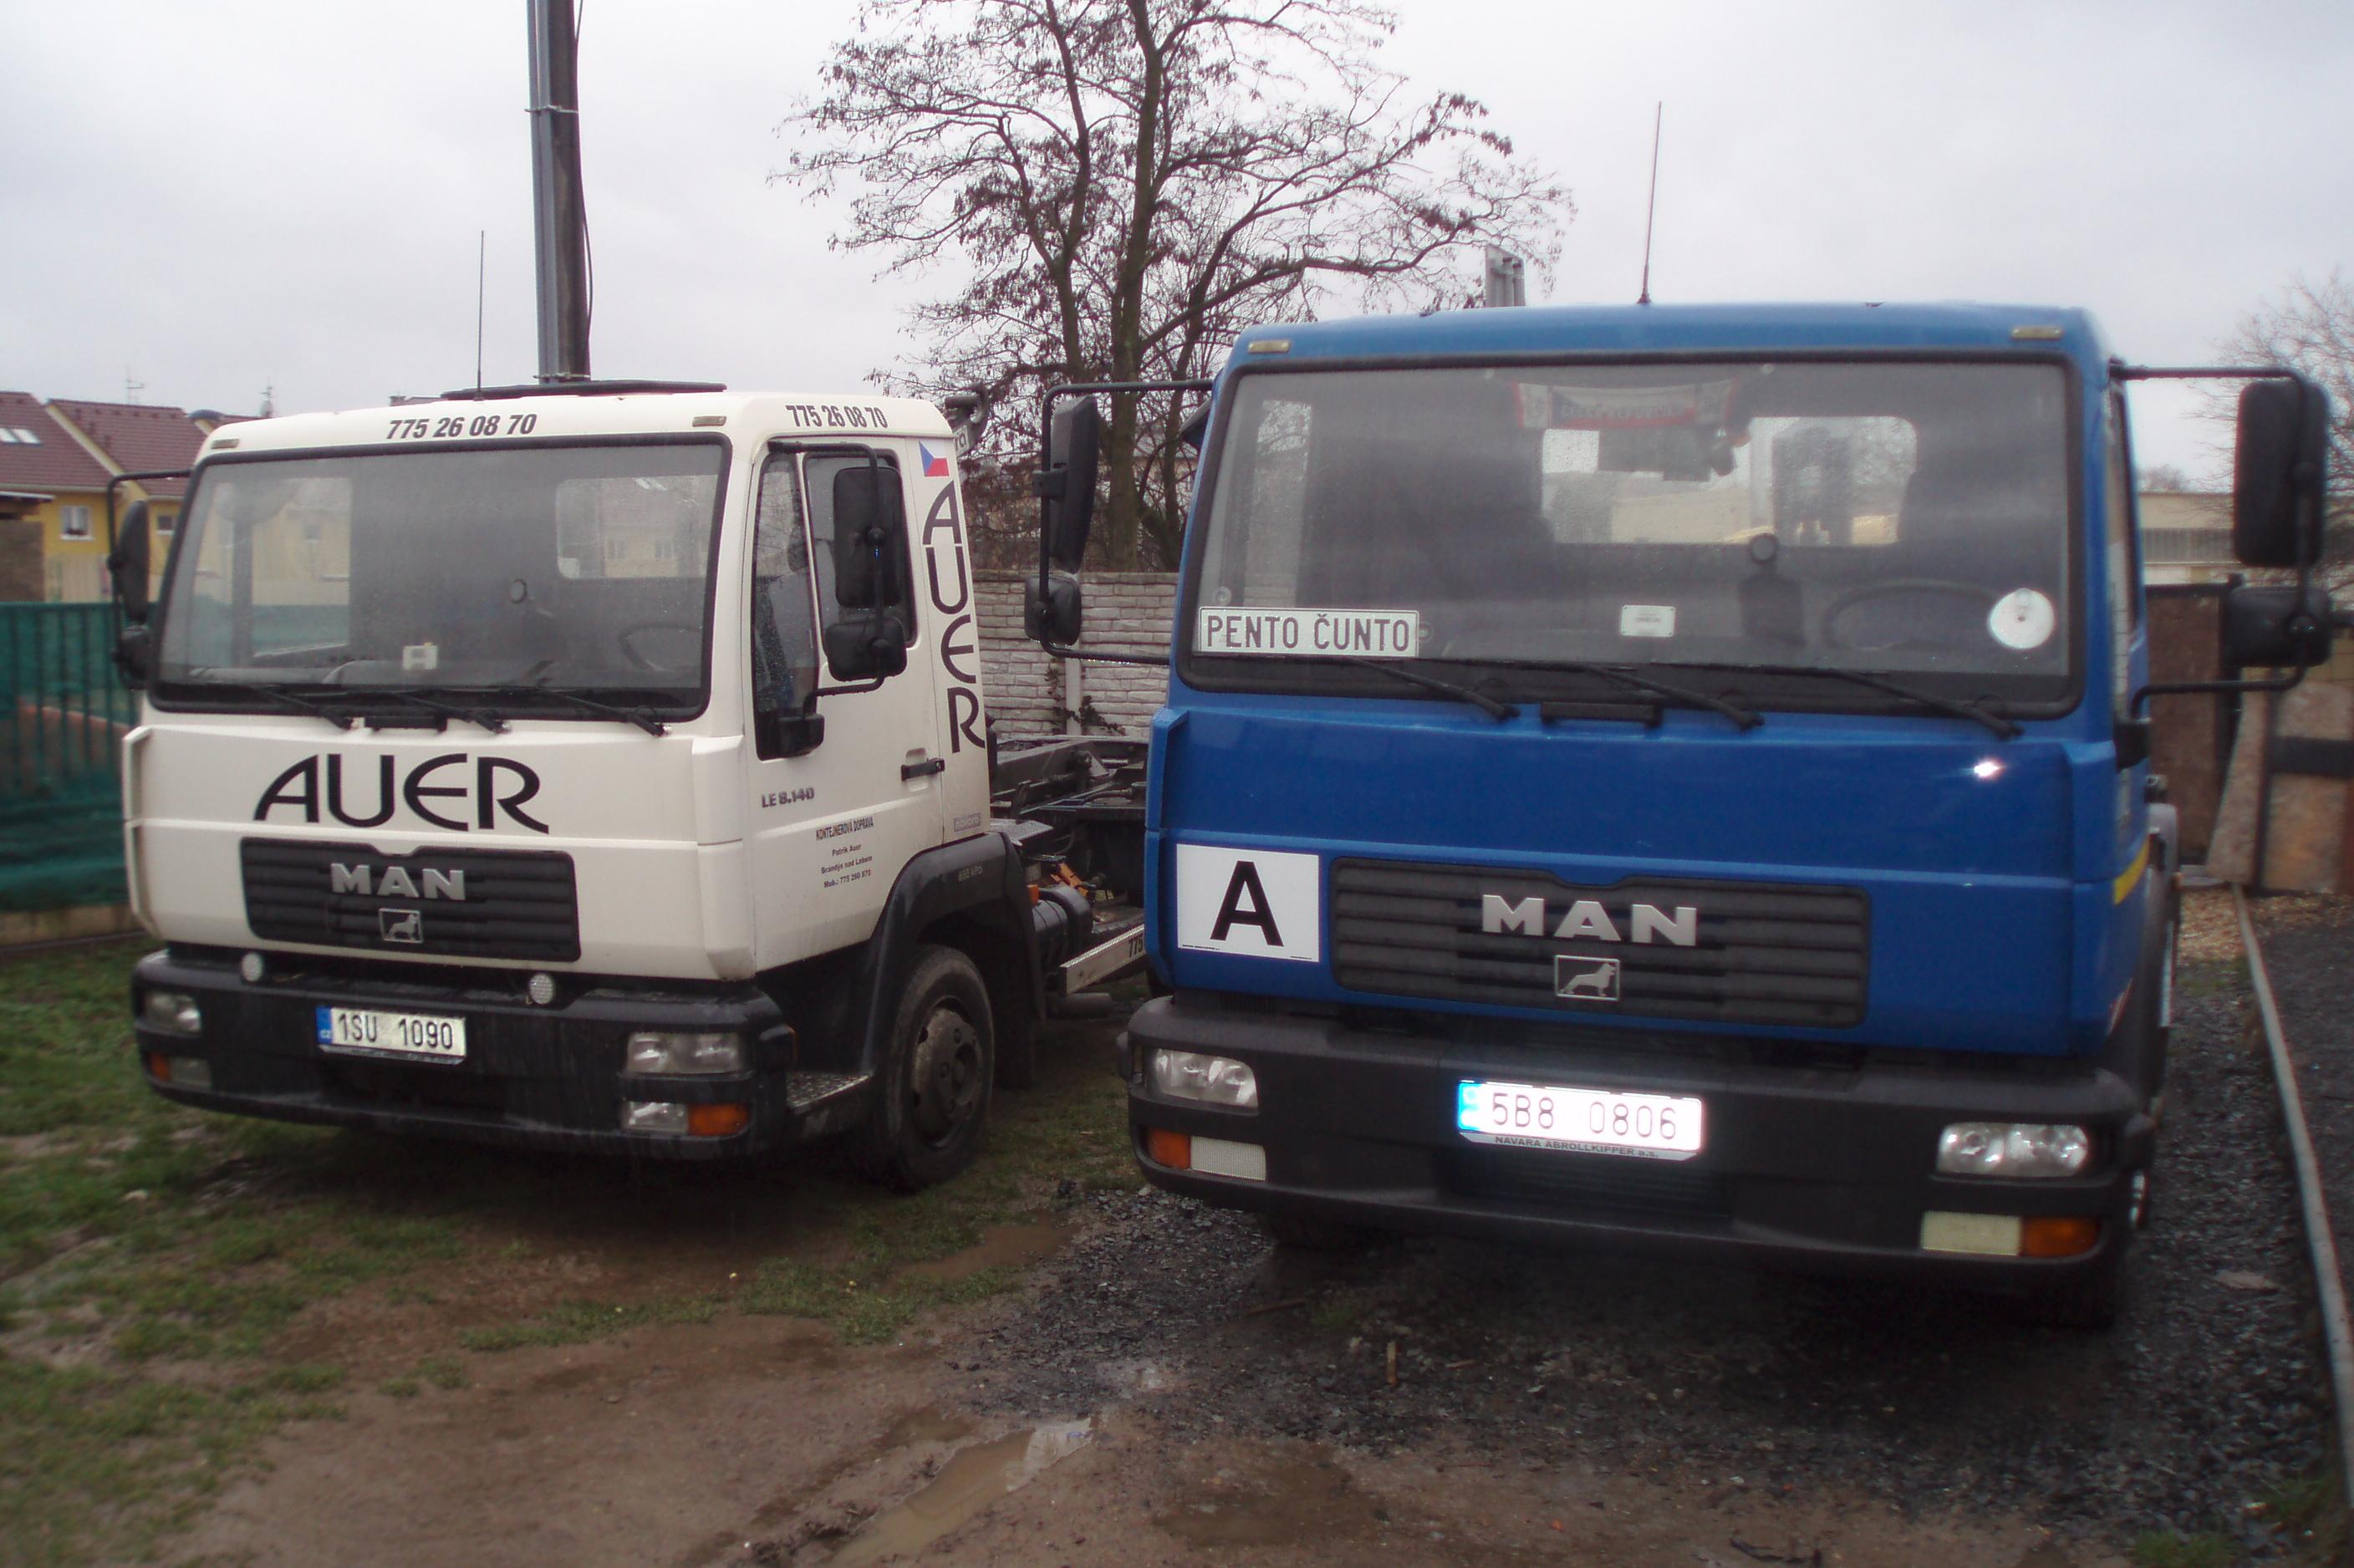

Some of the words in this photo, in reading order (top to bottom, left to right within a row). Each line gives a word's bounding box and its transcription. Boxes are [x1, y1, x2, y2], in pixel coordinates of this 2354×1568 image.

[386, 418, 430, 440] 775
[433, 416, 465, 438] 26
[469, 415, 501, 436] 08
[507, 413, 538, 435] 70
[785, 405, 823, 427] 775
[821, 405, 846, 427] 26
[843, 405, 868, 428] 08
[864, 406, 889, 429] 70
[922, 480, 986, 754] AUER
[1207, 614, 1299, 649] PENTO
[1313, 613, 1409, 652] ČUNTO
[252, 752, 549, 835] AUER
[761, 792, 777, 807] LE
[778, 787, 815, 805] 8.140
[853, 816, 874, 832] DOPRAVA
[330, 863, 466, 901] MAN
[1210, 860, 1285, 947] A
[1482, 894, 1697, 946] MAN
[339, 1013, 377, 1042] 1SU
[398, 1018, 453, 1049] 1090
[1492, 1092, 1555, 1129] 5B8
[1589, 1101, 1677, 1140] 0806
[1495, 1135, 1542, 1148] NAVARA
[1545, 1140, 1635, 1157] ABROLLKIPPER
